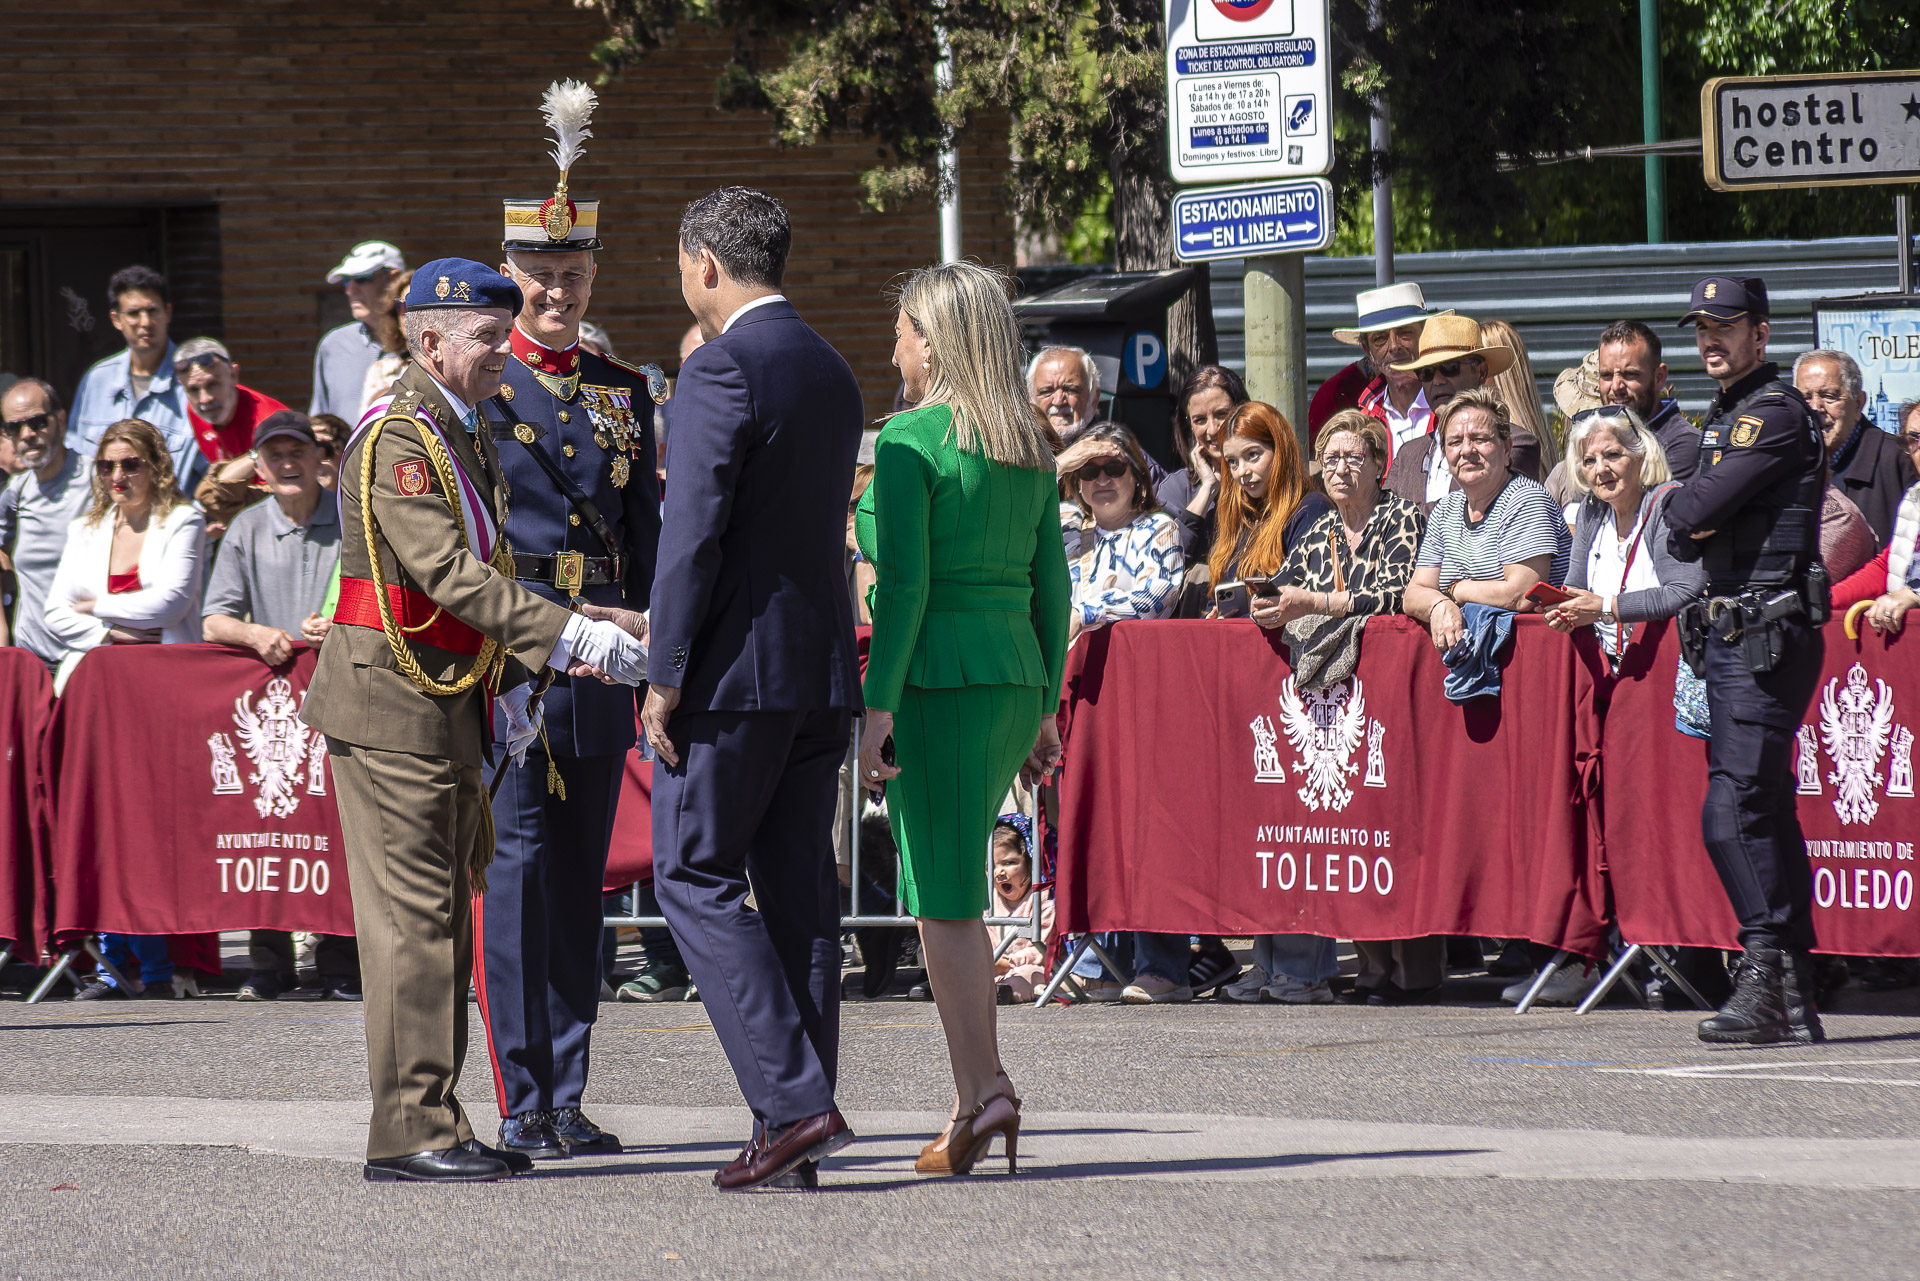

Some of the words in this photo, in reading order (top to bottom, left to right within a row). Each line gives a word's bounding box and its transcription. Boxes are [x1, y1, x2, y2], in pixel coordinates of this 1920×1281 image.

[1178, 48, 1198, 60] ZONA
[1199, 47, 1209, 58] DE
[1210, 43, 1274, 57] ESTACIONAMIENTO
[1274, 40, 1313, 52] REGULADO
[1187, 61, 1211, 73] TICKET
[1214, 60, 1223, 71] DE
[1224, 57, 1257, 70] CONTROL
[1257, 54, 1305, 68] OBLIGATORIO
[1188, 93, 1197, 102] 10
[1205, 93, 1213, 101] 14
[1214, 91, 1220, 101] h
[1221, 93, 1226, 101] y
[1227, 91, 1237, 100] de
[1239, 90, 1247, 99] 17
[1255, 89, 1264, 98] 20
[1265, 88, 1270, 97] h
[1193, 83, 1216, 92] Lunes
[1217, 82, 1222, 90] a
[1224, 80, 1251, 90] Viernes
[1252, 79, 1264, 88] de:
[1190, 102, 1222, 113] Sábados
[1223, 101, 1235, 111] de:
[1237, 101, 1246, 109] 10
[1253, 99, 1262, 108] 14
[1263, 98, 1269, 108] h
[1732, 92, 1864, 129] hostal
[1193, 114, 1218, 124] JULIO
[1221, 113, 1226, 121] Y
[1229, 111, 1265, 122] AGOSTO
[1192, 127, 1216, 138] Lunes
[1223, 124, 1252, 136] sábados
[1255, 124, 1268, 133] de:
[1214, 136, 1223, 146] 10
[1231, 135, 1240, 144] 14
[1241, 135, 1247, 144] h
[1182, 152, 1219, 162] Domingos
[1221, 152, 1226, 160] y
[1227, 149, 1258, 159] festivos:
[1260, 148, 1278, 157] Libre
[1733, 132, 1879, 168] Centro
[1182, 191, 1315, 225] ESTACIONAMIENTO
[1212, 224, 1235, 247] EN
[1238, 220, 1287, 245] LINEA
[1136, 334, 1161, 385] P
[313, 835, 329, 851] DE
[1256, 825, 1369, 846] AYUNTAMIENTO
[1374, 830, 1391, 848] DE
[1804, 839, 1893, 860] YUNTAMIENTO
[1895, 841, 1915, 861] DE
[1255, 851, 1394, 896] TOLEDO
[1813, 867, 1914, 911] OLEDO
